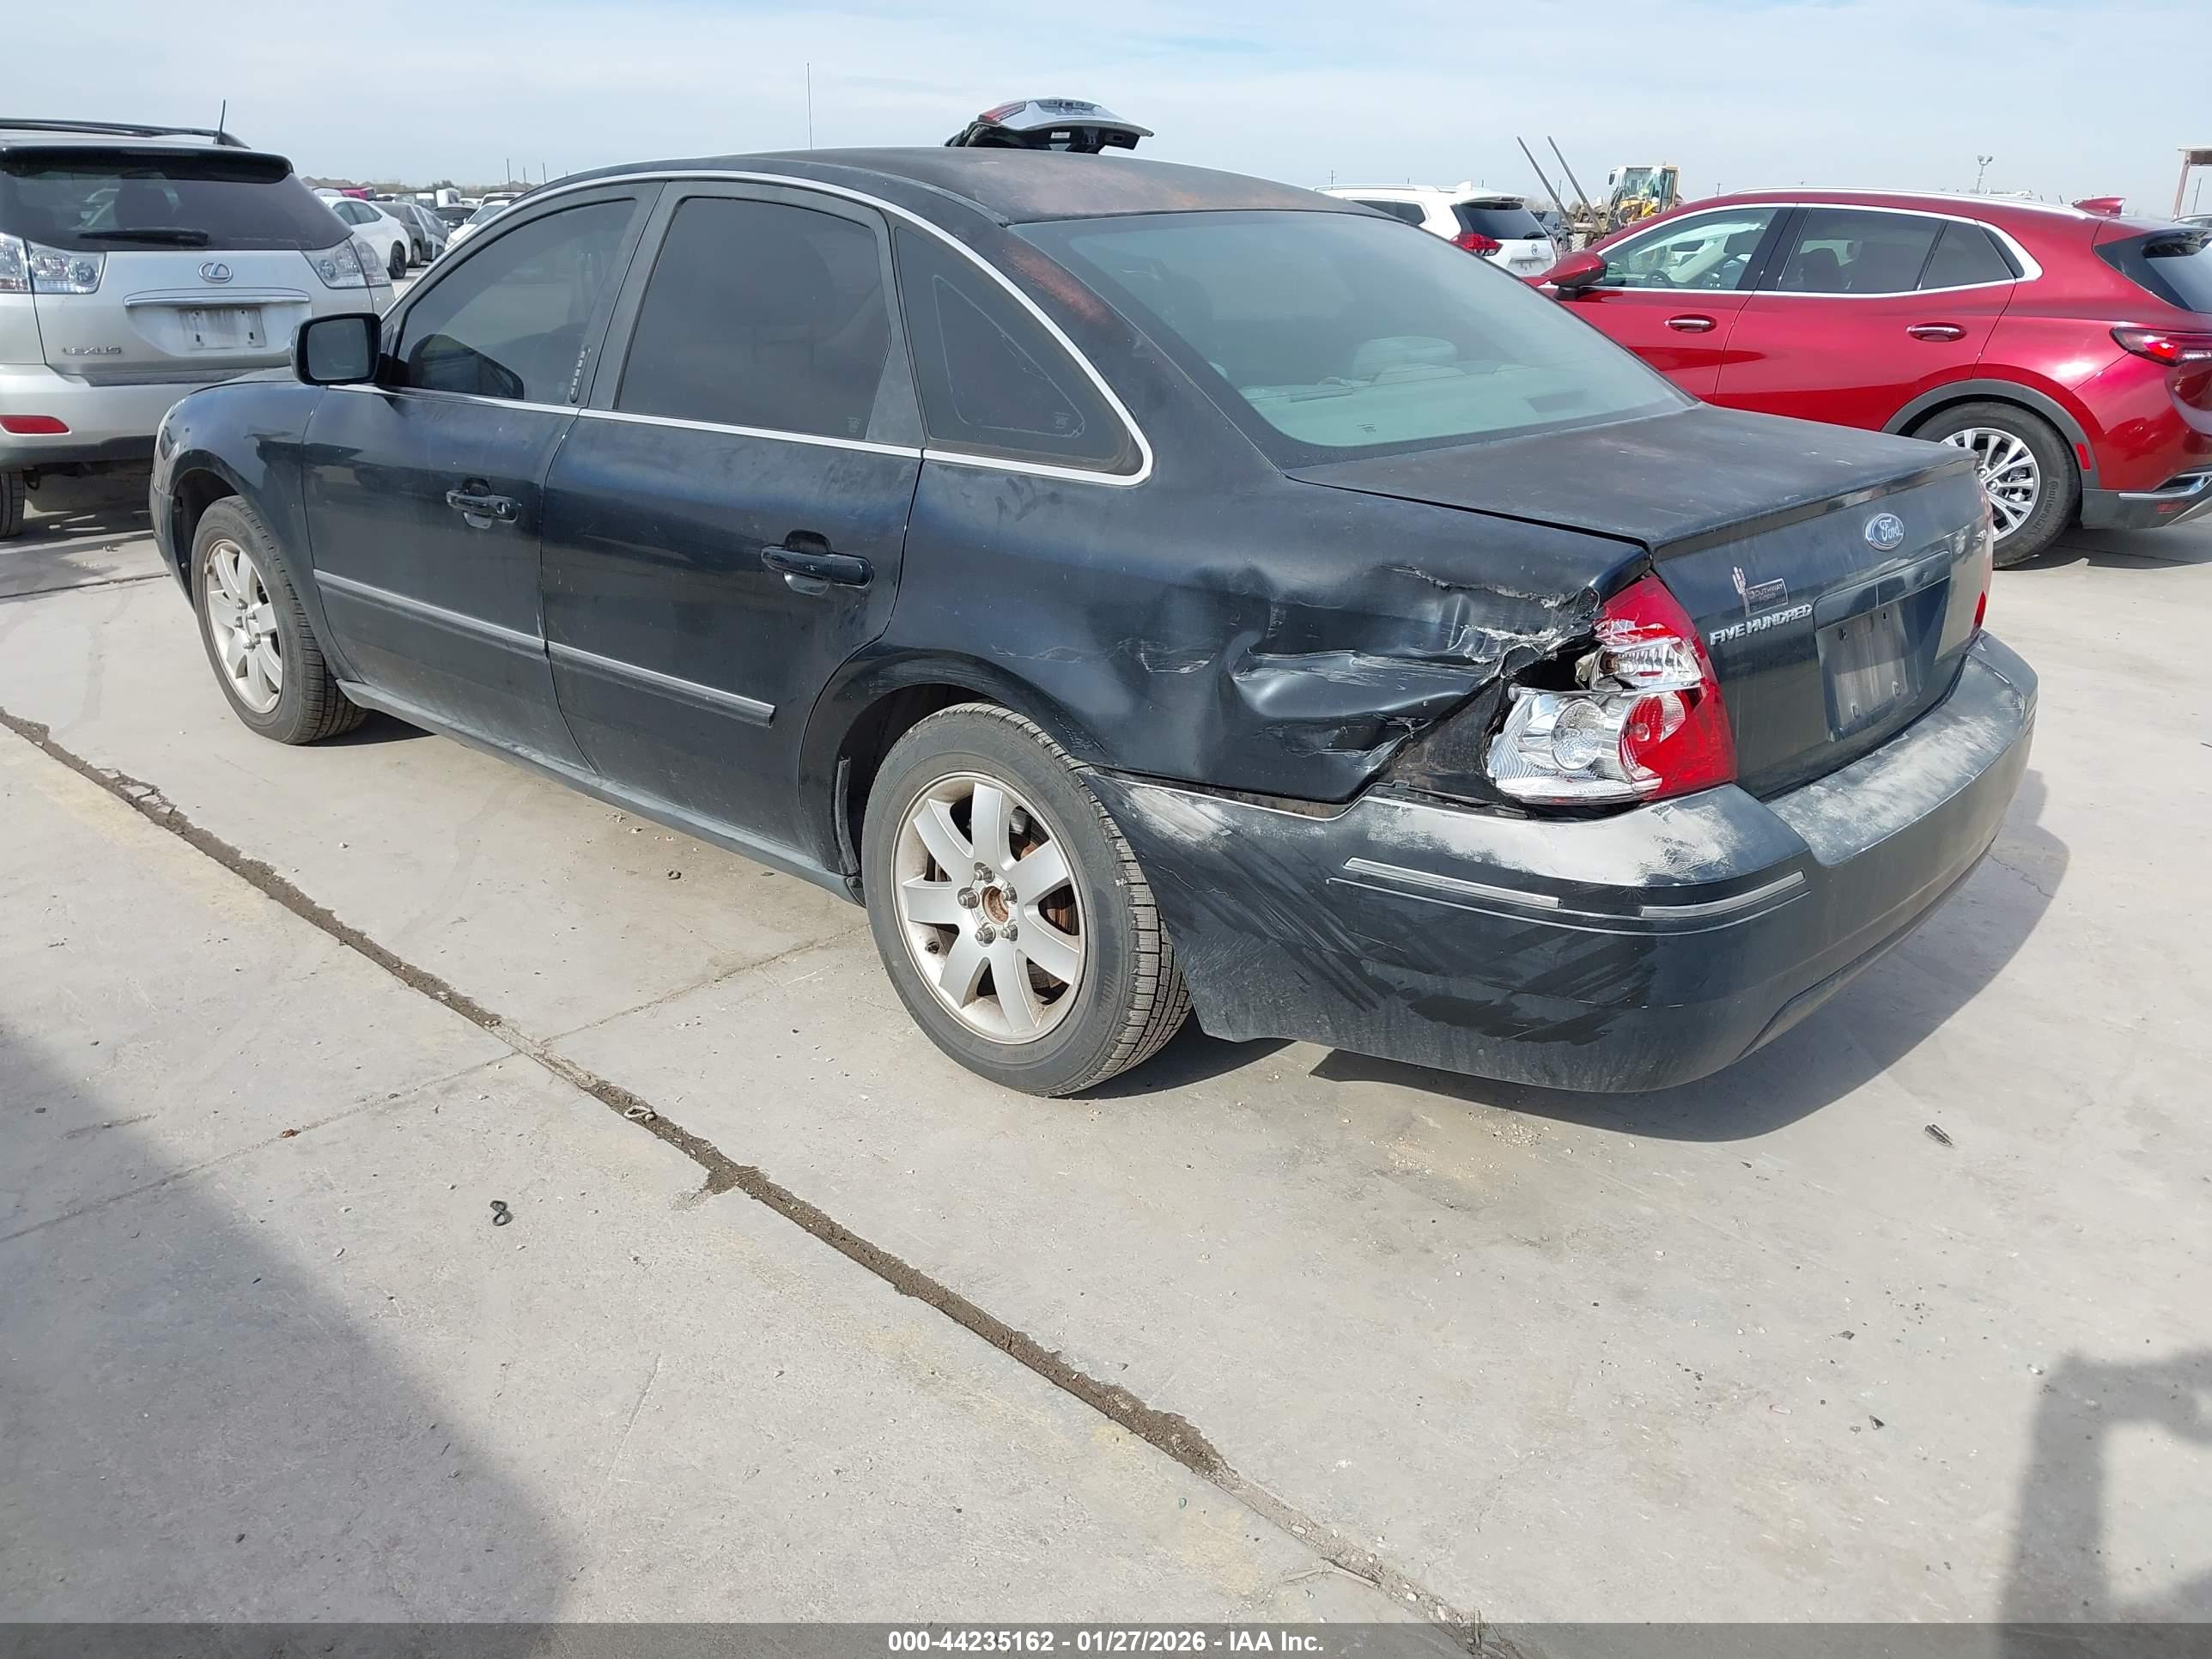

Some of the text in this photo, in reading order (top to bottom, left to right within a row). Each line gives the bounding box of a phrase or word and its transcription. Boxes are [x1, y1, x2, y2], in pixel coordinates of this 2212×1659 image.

[62, 346, 122, 356] LEXUS
[1879, 517, 1903, 541] Ford
[1709, 623, 1746, 646] FIVE
[1746, 604, 1813, 635] HUNDRED
